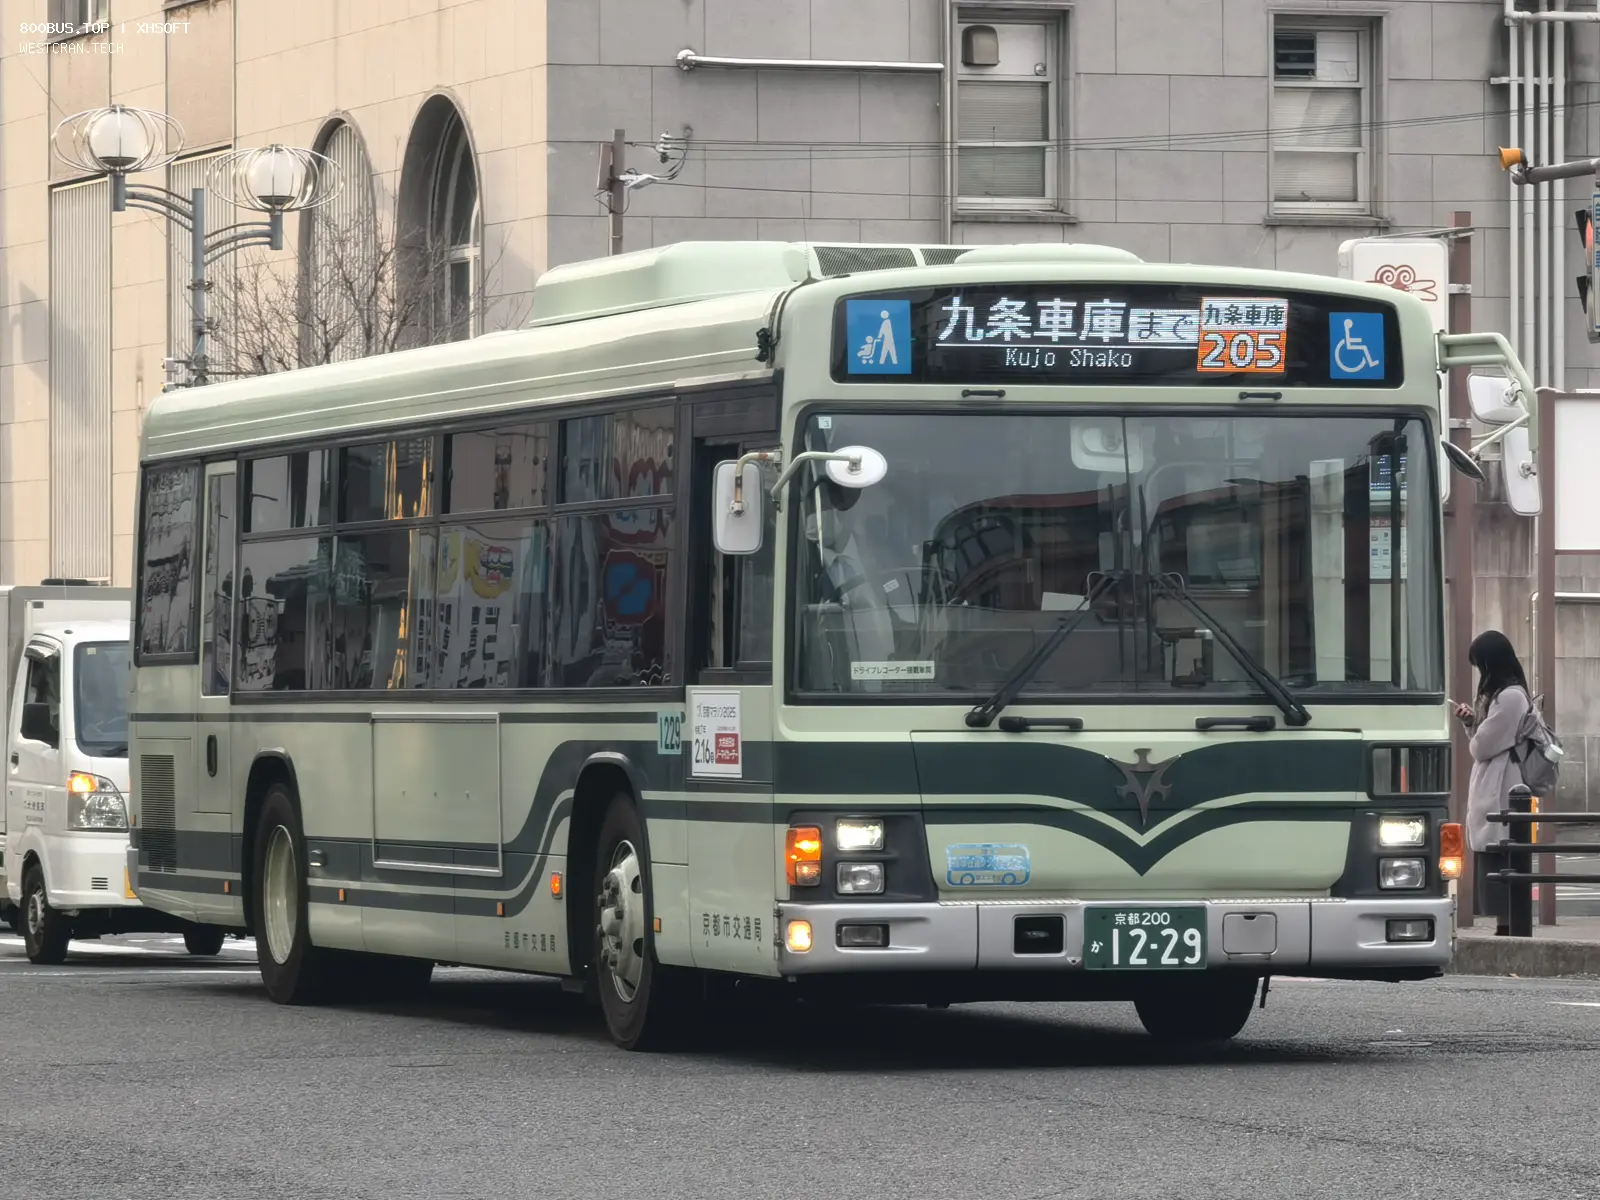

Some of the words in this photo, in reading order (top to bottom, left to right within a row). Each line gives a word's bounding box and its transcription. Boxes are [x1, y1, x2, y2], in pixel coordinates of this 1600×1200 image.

[1005, 347, 1056, 368] Kujo
[1069, 348, 1133, 368] Shako
[1201, 331, 1282, 368] 205
[660, 716, 680, 750] 1229
[1090, 940, 1104, 954] か
[1112, 927, 1202, 966] 12-29
